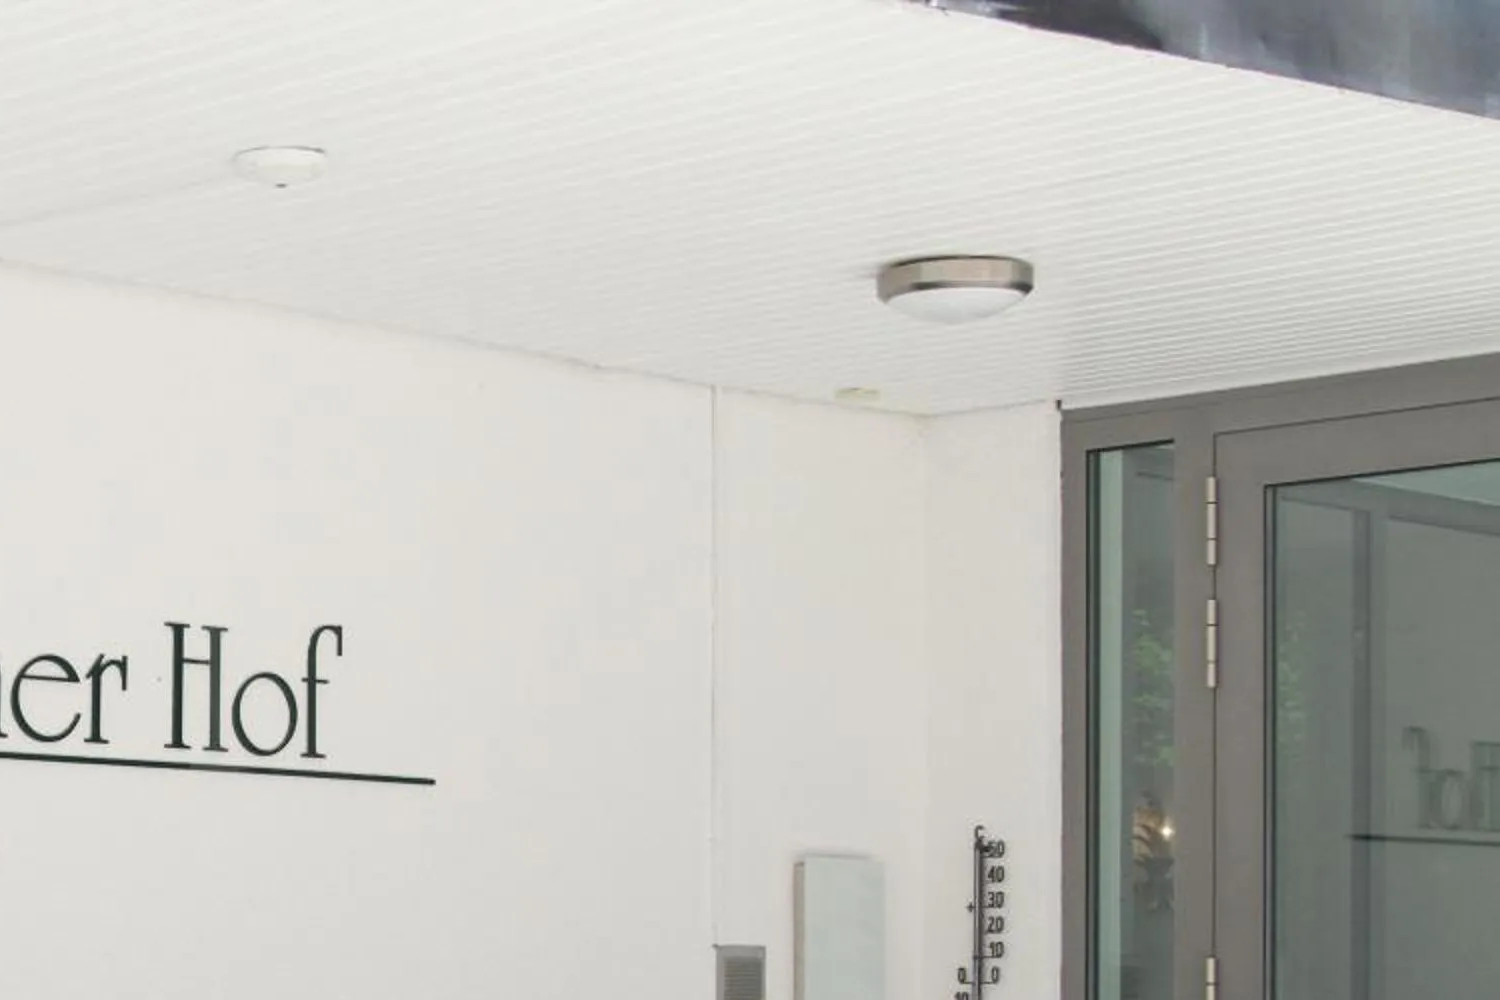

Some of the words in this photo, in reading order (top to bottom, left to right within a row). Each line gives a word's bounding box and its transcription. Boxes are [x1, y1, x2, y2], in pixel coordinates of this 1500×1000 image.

[162, 621, 343, 759] Hof
[987, 865, 1005, 883] 40
[987, 891, 1005, 908] 30
[987, 915, 1005, 934] 20
[989, 941, 1005, 958] 10
[957, 967, 967, 985] 0
[991, 965, 1000, 984] 0
